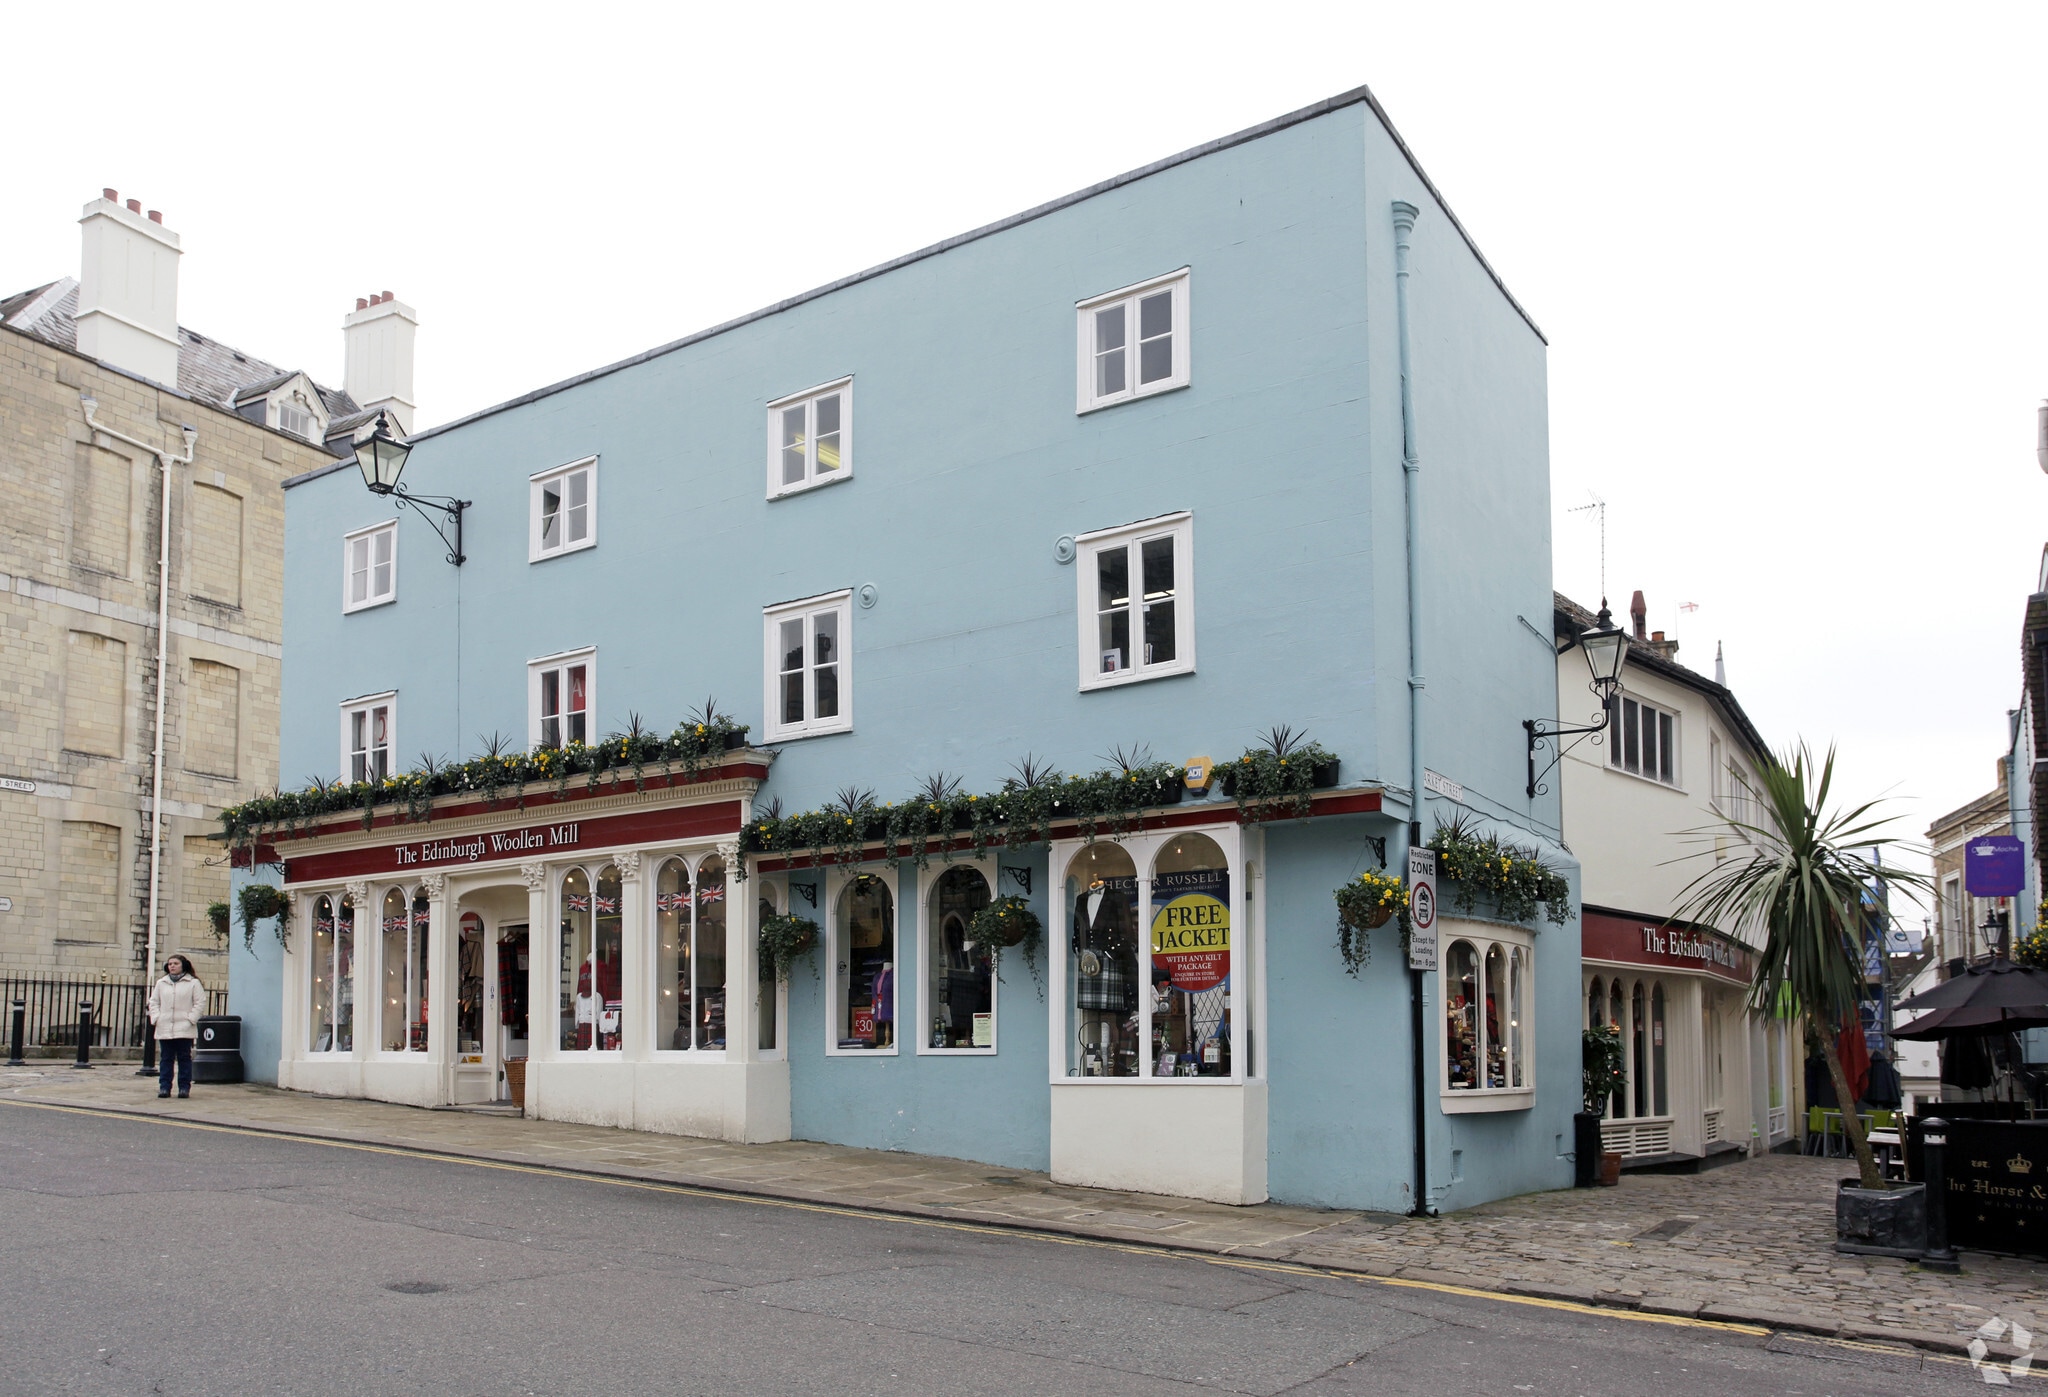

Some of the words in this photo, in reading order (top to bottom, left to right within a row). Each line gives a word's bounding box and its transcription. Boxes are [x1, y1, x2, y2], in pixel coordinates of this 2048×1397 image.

[1187, 768, 1203, 778] ADT
[5, 780, 32, 790] STREET
[1442, 781, 1461, 799] STREET
[395, 846, 417, 865] The
[421, 836, 486, 861] Edinburgh
[490, 830, 544, 853] Woollen
[549, 823, 578, 846] Mill
[1410, 849, 1434, 860] Restricted
[1411, 861, 1434, 876] ZONE
[1104, 877, 1160, 890] HECTR
[1167, 872, 1223, 886] RUSSELL
[1166, 904, 1222, 927] FREE
[1156, 927, 1230, 953] JACKET
[1412, 936, 1428, 945] Except
[1643, 927, 1666, 954] The
[1205, 953, 1222, 961] KILT
[1415, 946, 1433, 956] Loading
[1177, 962, 1212, 971] PACKAGE
[855, 1019, 873, 1032] £30
[1946, 1177, 1967, 1192] he
[1972, 1179, 2024, 1198] Horse
[2029, 1184, 2047, 1200] &
